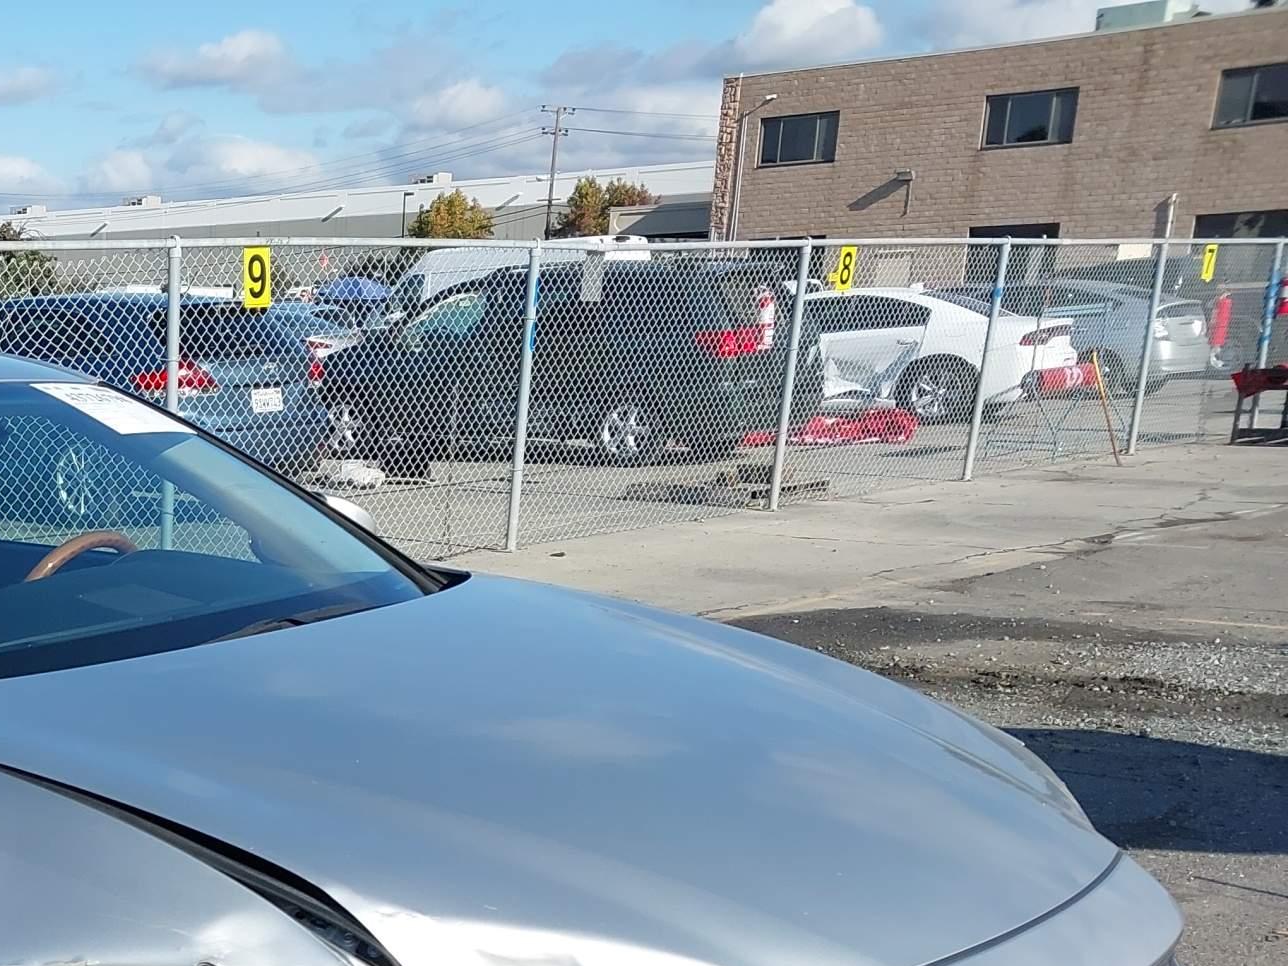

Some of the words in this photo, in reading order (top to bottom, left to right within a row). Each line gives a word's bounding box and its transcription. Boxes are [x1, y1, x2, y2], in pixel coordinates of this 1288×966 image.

[248, 254, 267, 299] 9
[840, 252, 853, 285] 8
[1205, 248, 1217, 274] 7
